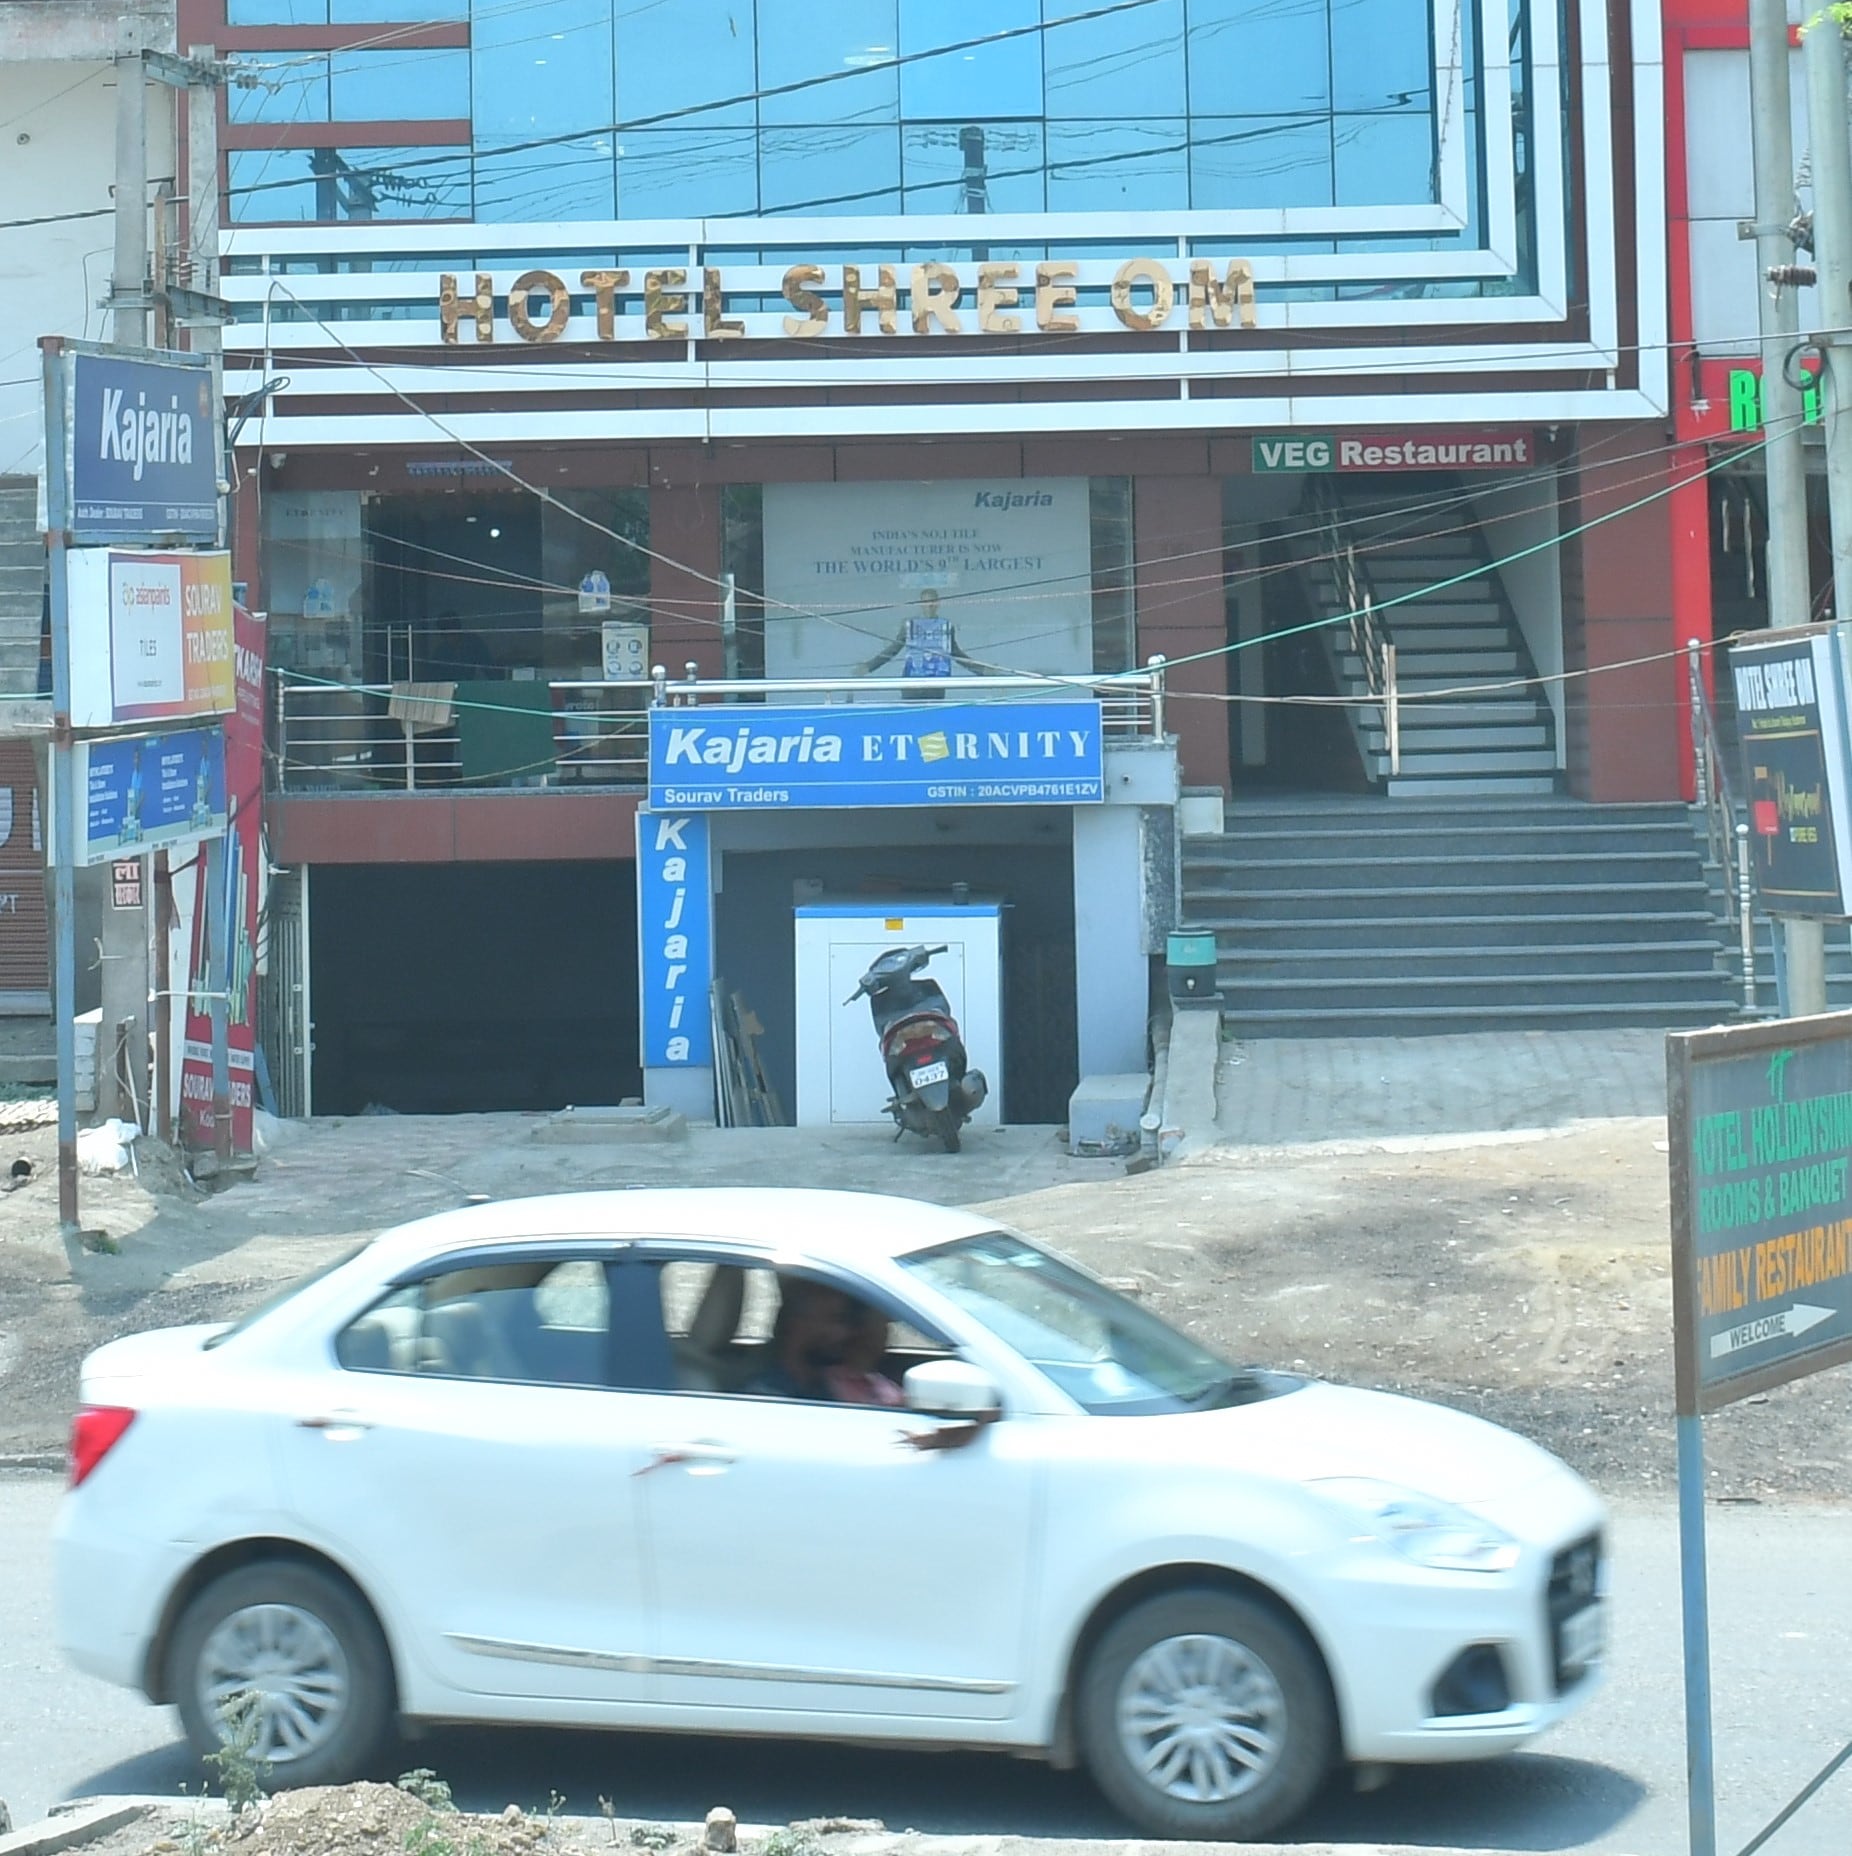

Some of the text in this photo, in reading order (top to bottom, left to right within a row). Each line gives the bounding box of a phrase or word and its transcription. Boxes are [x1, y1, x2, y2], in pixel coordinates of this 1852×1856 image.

[439, 257, 1257, 344] HOTEL SHREE OM
[100, 387, 193, 482] Kajaria
[1260, 438, 1527, 468] VEG Restaurant
[974, 490, 1053, 511] Kajaria
[814, 560, 849, 574] THE
[853, 559, 934, 573] WORLD'S
[963, 556, 1043, 571] LARGEST
[851, 543, 1002, 556] MANUFACTURER IS NOW
[185, 584, 222, 617] SOURAV
[186, 629, 229, 664] TRADERS
[665, 726, 842, 774] Kajaria
[665, 787, 789, 804] Sourav Traders
[927, 785, 967, 798] GSTIN
[655, 818, 690, 1061] Kajaria
[1694, 1110, 1748, 1174] HOTEL
[1700, 1156, 1849, 1233] ROOMS & BANQUET
[1755, 1218, 1852, 1303] RESTAURANT
[1729, 1314, 1786, 1350] WELCOME
